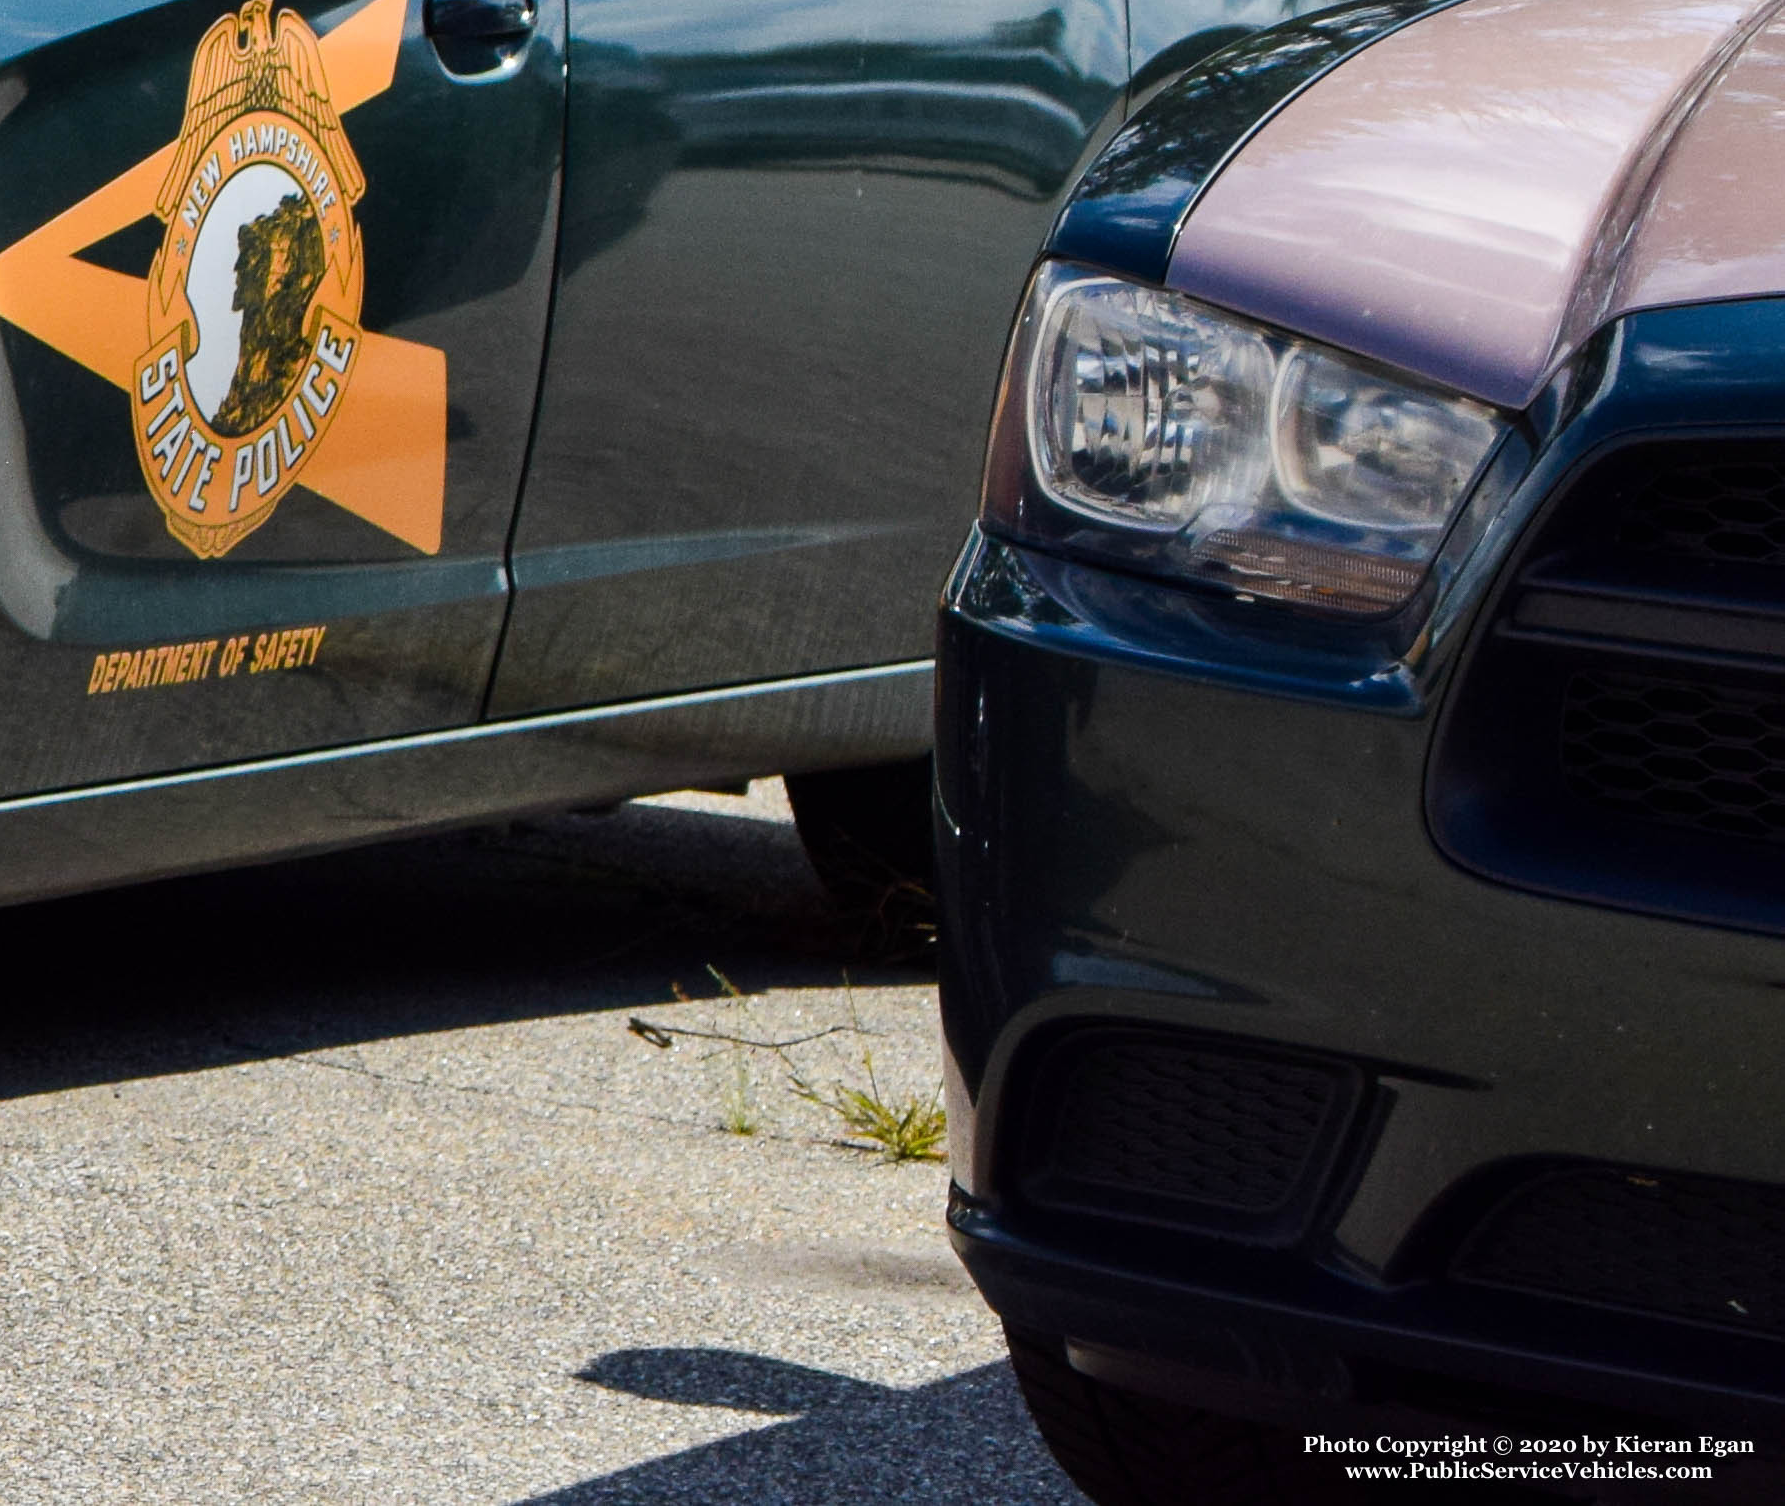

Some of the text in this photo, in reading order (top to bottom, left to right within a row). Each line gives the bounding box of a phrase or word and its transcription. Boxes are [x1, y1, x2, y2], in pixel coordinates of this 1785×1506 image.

[181, 123, 337, 229] NEW HAMPSHIRE
[141, 326, 355, 512] STATE POLICE
[87, 625, 327, 695] DEPARTMENT OF SAFETY
